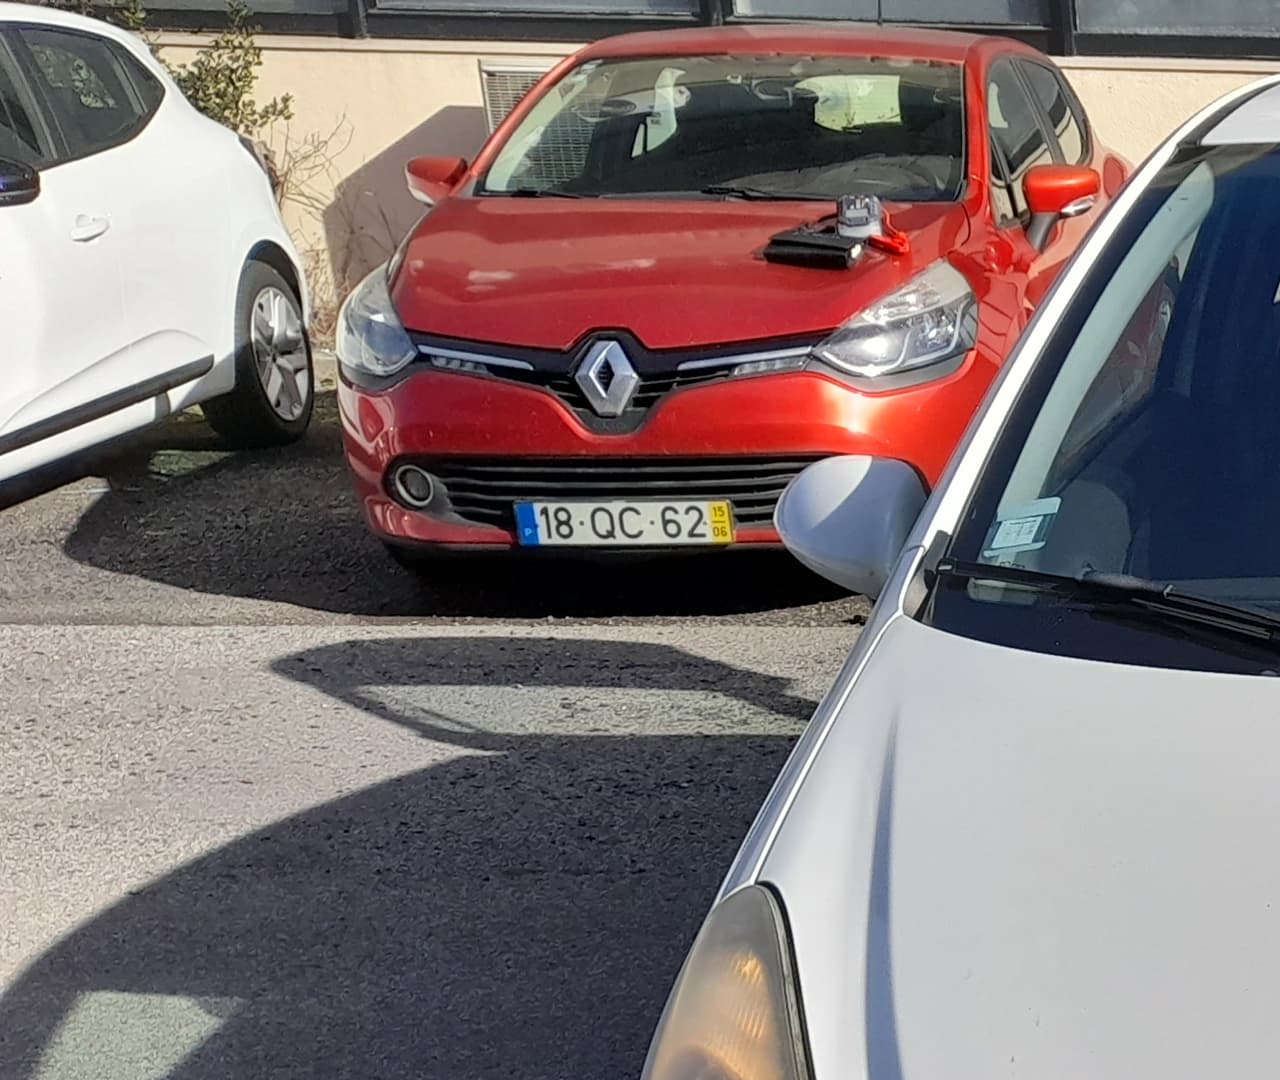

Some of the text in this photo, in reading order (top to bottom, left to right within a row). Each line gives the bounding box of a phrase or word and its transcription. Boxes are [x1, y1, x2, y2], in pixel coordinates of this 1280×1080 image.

[712, 506, 725, 517] 15
[524, 527, 533, 537] P
[712, 526, 728, 537] 06
